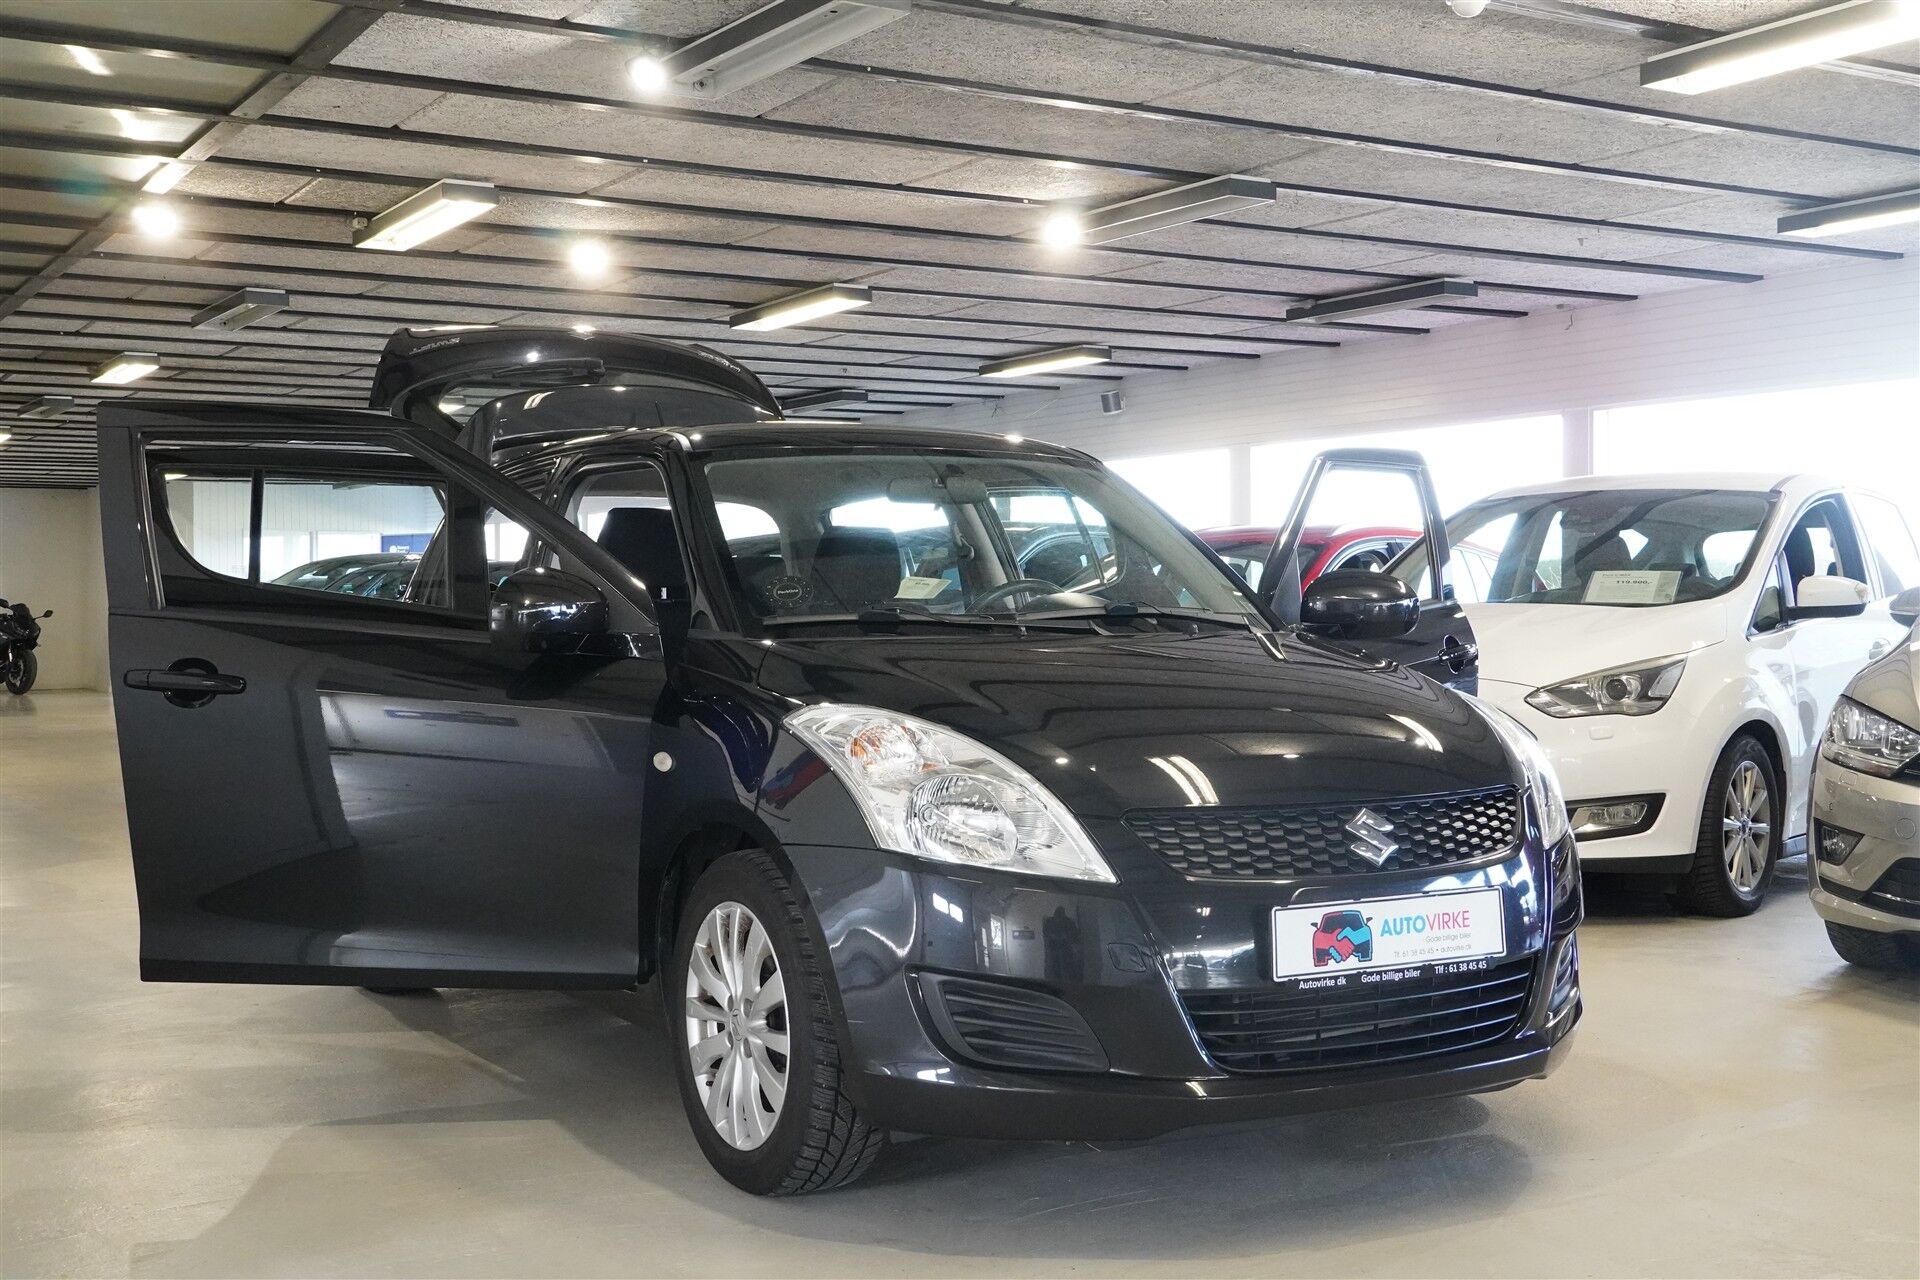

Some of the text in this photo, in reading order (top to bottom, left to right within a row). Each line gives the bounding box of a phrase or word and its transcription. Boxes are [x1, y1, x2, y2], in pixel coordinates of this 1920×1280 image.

[1380, 910, 1471, 937] AUTOVIRKE
[1361, 972, 1381, 983] Gode
[1382, 971, 1403, 981] billige
[1404, 968, 1421, 978] biler
[1449, 964, 1457, 973] 61
[1458, 962, 1468, 972] 38
[1468, 961, 1477, 970] 45
[1478, 960, 1487, 969] 45
